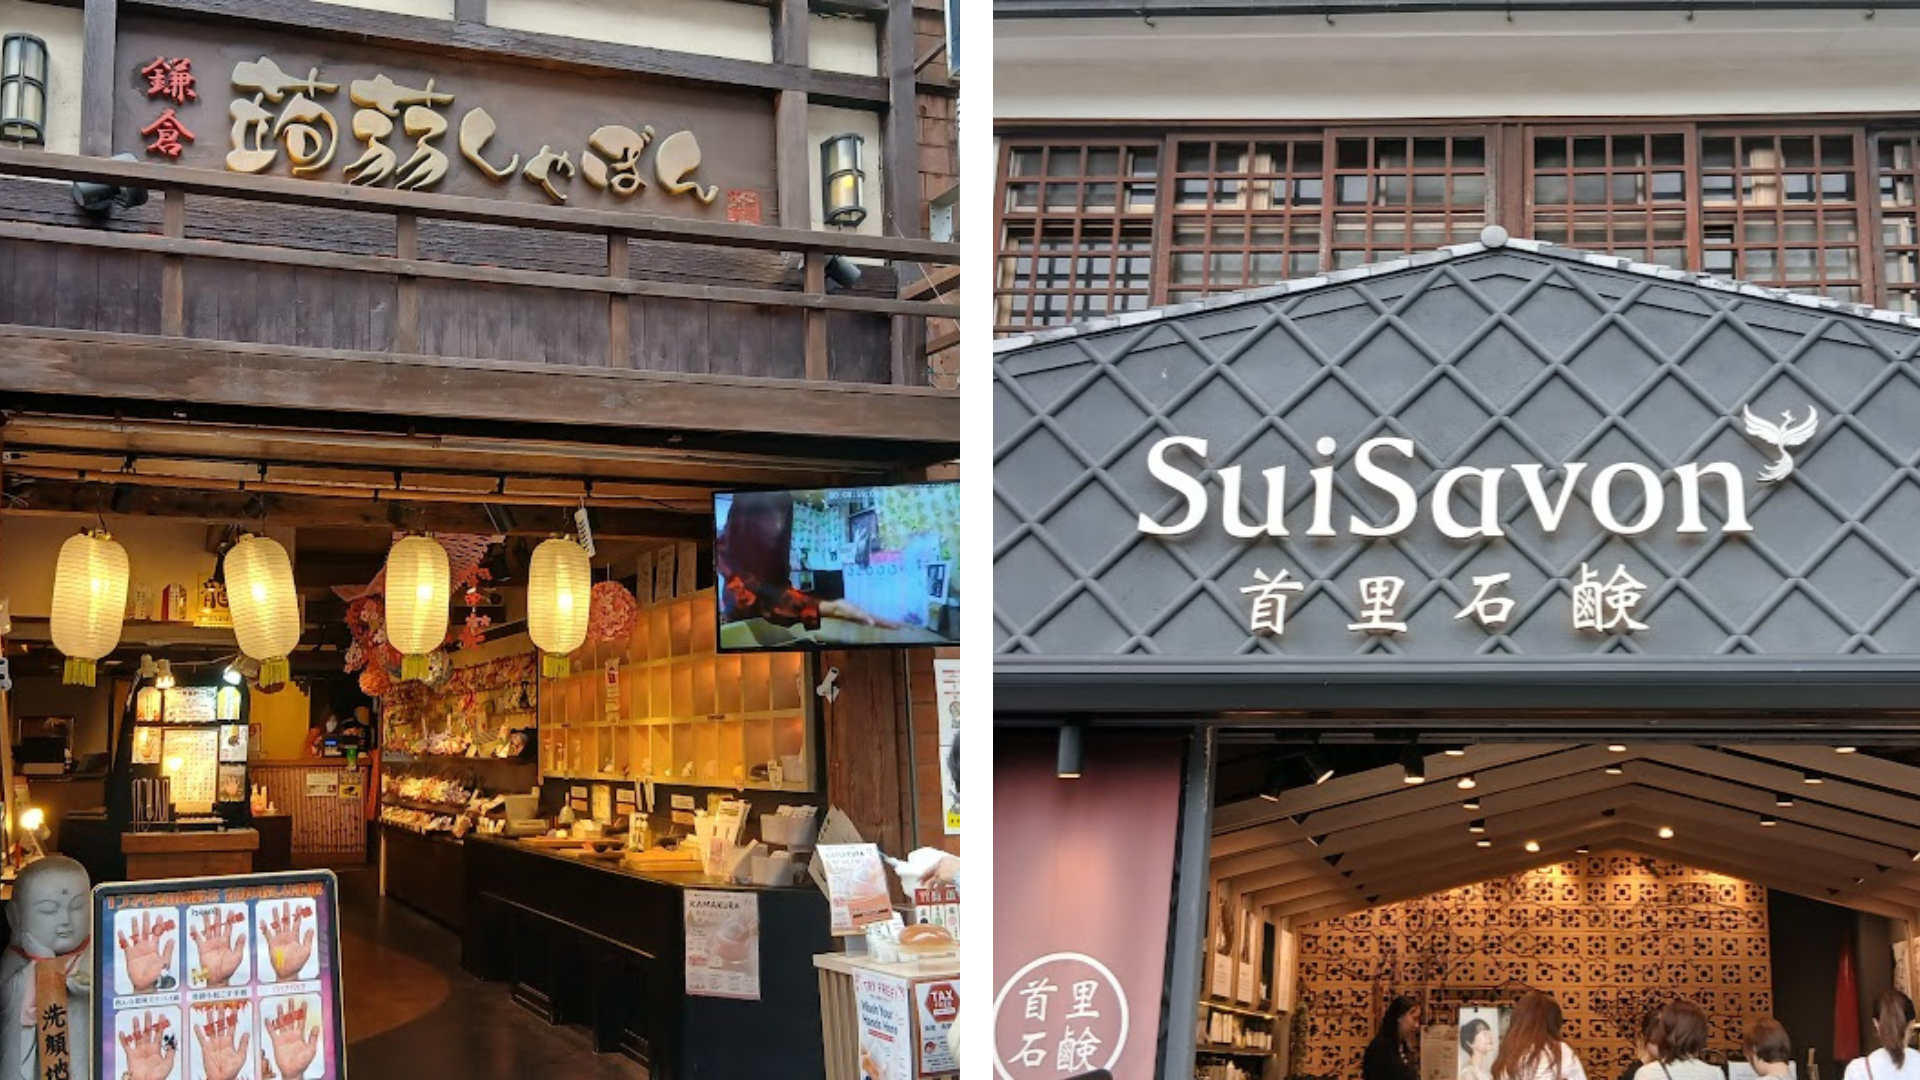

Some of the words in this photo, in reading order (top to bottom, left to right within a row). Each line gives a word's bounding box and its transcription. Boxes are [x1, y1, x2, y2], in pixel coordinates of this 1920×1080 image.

[140, 55, 197, 159] 鎌倉
[1136, 434, 1755, 539] SuiSavon
[1238, 562, 1650, 636] 首里石鹸
[931, 989, 955, 1003] TAX
[1019, 976, 1101, 1022] 首里
